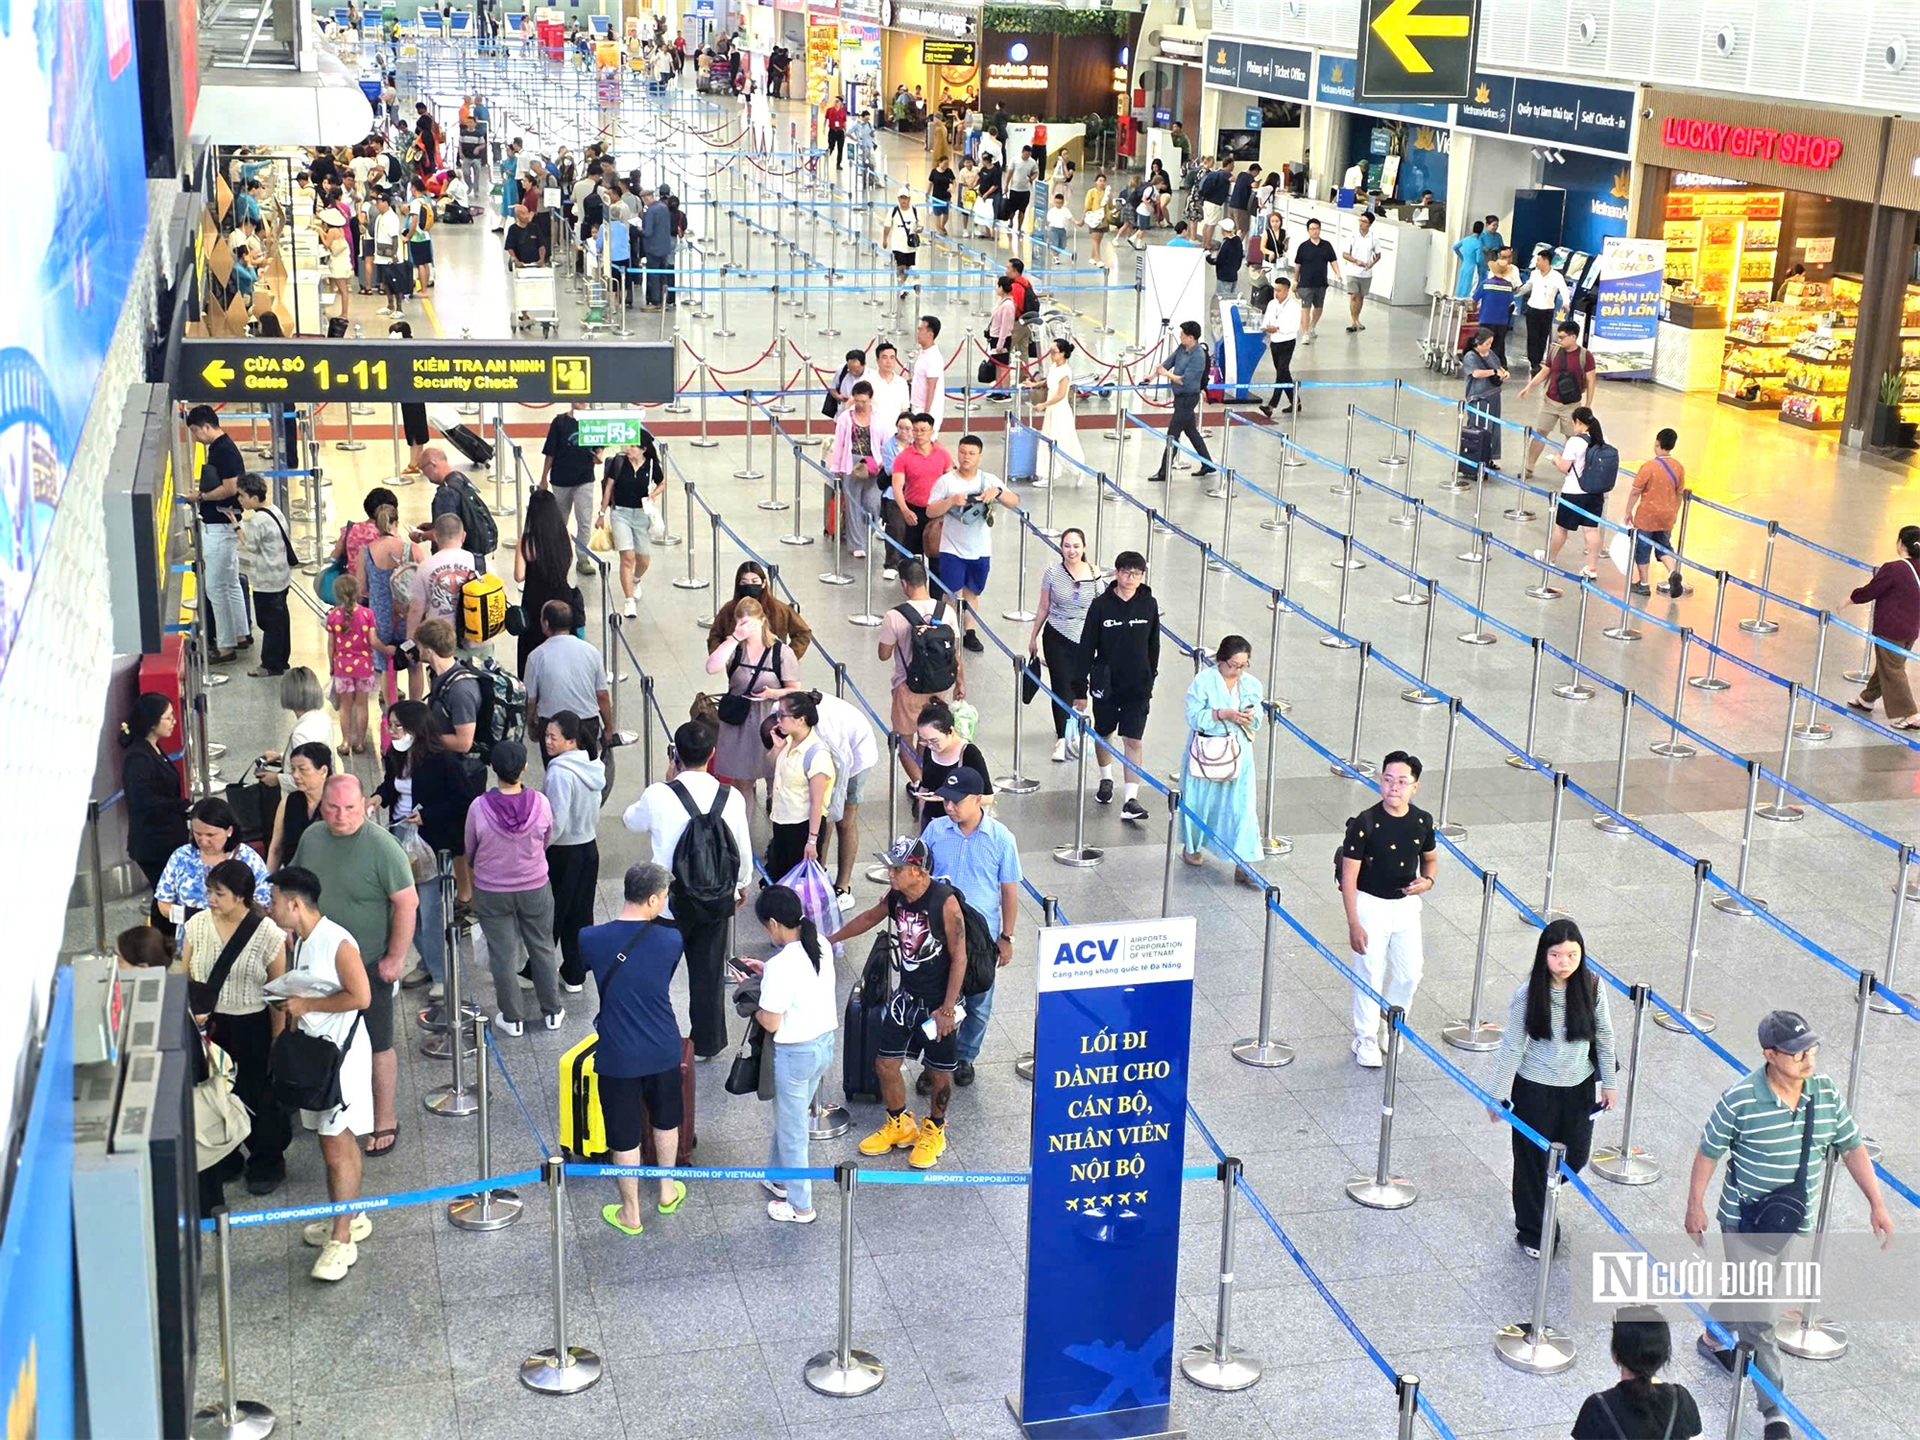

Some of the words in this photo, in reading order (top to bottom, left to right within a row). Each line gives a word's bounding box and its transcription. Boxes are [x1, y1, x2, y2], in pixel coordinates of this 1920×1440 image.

[989, 62, 1027, 76] THÔNG
[1029, 65, 1048, 76] TIN
[1274, 64, 1290, 79] Ticket
[1290, 66, 1306, 82] Office
[988, 77, 1048, 88] Information
[1581, 110, 1595, 124] Self
[1664, 117, 1730, 152] LUCKY
[1729, 125, 1780, 160] GIFT
[1778, 132, 1843, 169] SHOP
[1611, 249, 1634, 259] FLY
[1618, 262, 1656, 272] SHOP
[1600, 290, 1638, 303] NHẬN
[1601, 304, 1625, 317] ĐÃI
[1628, 303, 1657, 317] LỚN
[243, 355, 281, 372] CỬA
[281, 355, 306, 372] SỐ
[412, 356, 450, 372] KIỂM
[452, 359, 484, 372] TRA
[485, 359, 507, 372] AN
[509, 359, 546, 373] NINH
[245, 374, 289, 389] Gates
[413, 376, 471, 391] Security
[473, 376, 519, 389] Check
[583, 434, 606, 443] EXIT
[1130, 934, 1168, 943] AIRPORTS
[1053, 938, 1119, 965] ACV
[1129, 941, 1183, 952] CORPORATION
[1129, 952, 1139, 960] OF
[1141, 949, 1174, 959] VIETNAM
[1095, 966, 1119, 975] không
[1120, 963, 1139, 973] quốc
[1140, 963, 1148, 971] tế
[1150, 962, 1160, 970] Đà
[1080, 1026, 1118, 1054] LỐI
[1122, 1030, 1148, 1050] ĐI
[1054, 1063, 1119, 1089] DÀNH
[1123, 1060, 1170, 1082] CHO
[1067, 1094, 1113, 1119] CÁN
[1117, 1089, 1153, 1116] BỘ,
[1048, 1126, 1113, 1153] NHÂN
[1117, 1120, 1171, 1146] VIÊN
[600, 1168, 644, 1177] AIRPORTS
[645, 1168, 709, 1178] CORPORATION
[711, 1169, 723, 1178] OF
[725, 1170, 765, 1179] VIETNAM
[1070, 1157, 1111, 1184] NỘI
[1115, 1152, 1146, 1179] BỘ
[923, 1174, 964, 1183] AIRPORTS
[965, 1175, 1027, 1183] CORPORATION
[229, 1213, 264, 1225] RPORTS
[265, 1206, 333, 1221] CORPORATION
[334, 1204, 346, 1213] OF
[349, 1198, 389, 1211] VIETNAM
